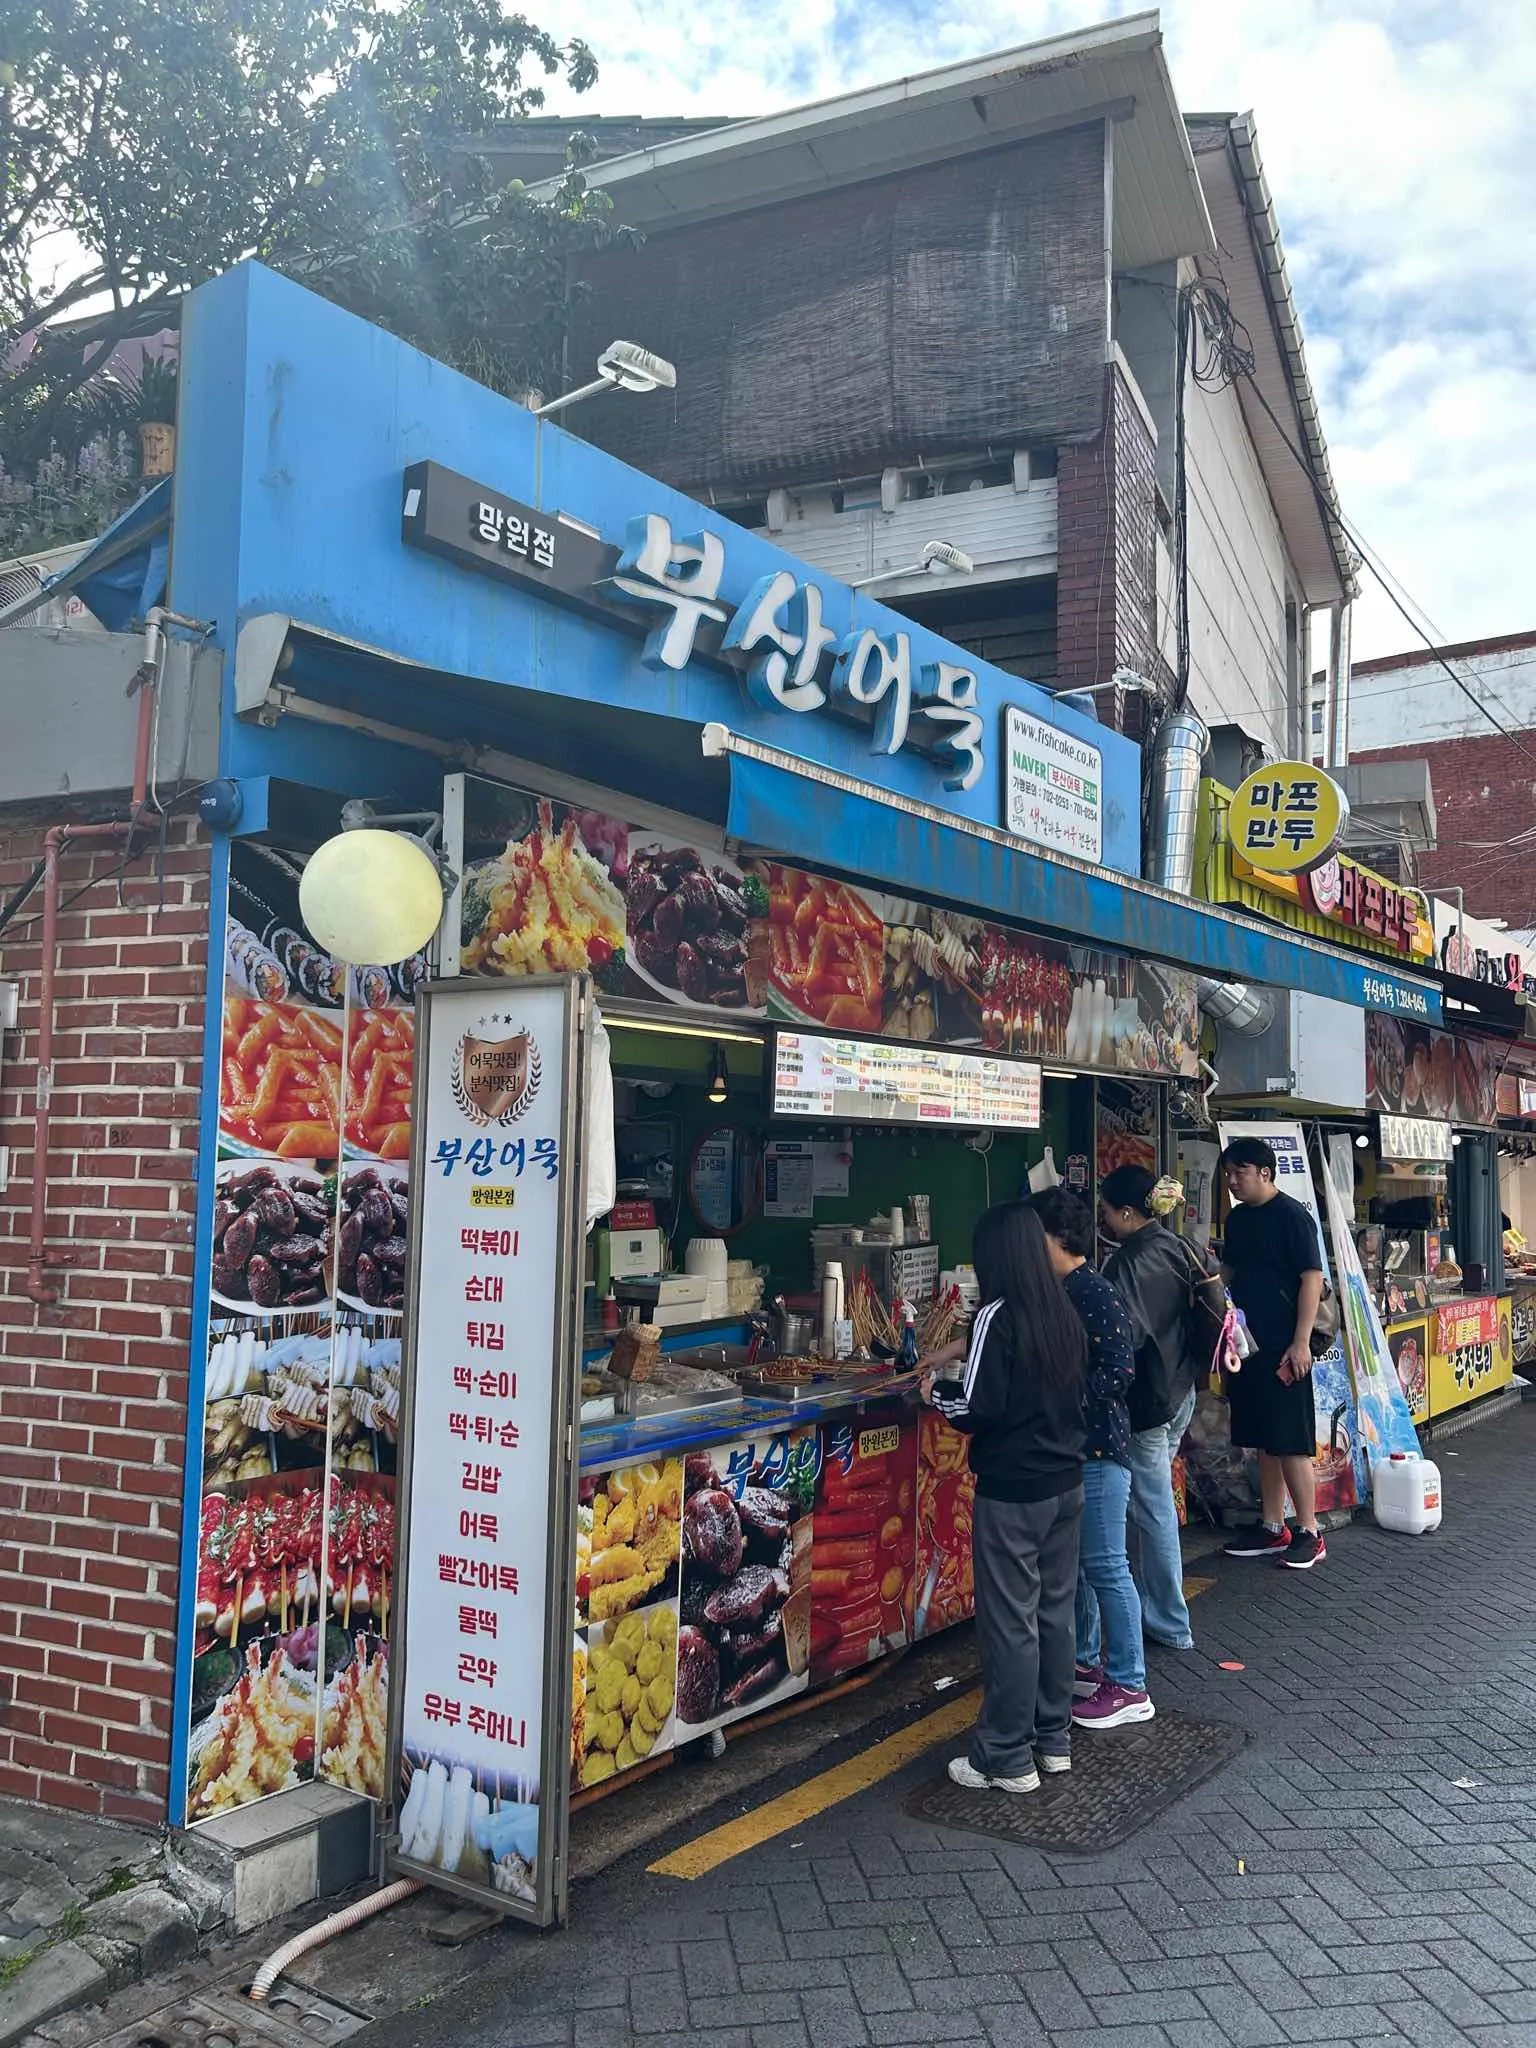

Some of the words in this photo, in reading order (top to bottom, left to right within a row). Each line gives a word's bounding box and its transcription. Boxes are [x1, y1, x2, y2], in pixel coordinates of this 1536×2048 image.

[478, 501, 556, 569] 망원점
[606, 512, 986, 792] 부산어묵
[1013, 750, 1047, 781] NAVER
[1051, 768, 1082, 795] 부산어묵
[1250, 780, 1319, 813] 마포
[1245, 817, 1316, 852] 만두
[1342, 867, 1419, 953] 마포만두
[469, 1051, 522, 1070] 어묵맛집!
[469, 1074, 522, 1094] 분식맛집!
[430, 1137, 561, 1181] 부산어묵
[471, 1188, 515, 1206] 망원본점
[460, 1228, 519, 1257] 떡볶이
[464, 1275, 504, 1304] 순대
[466, 1321, 504, 1351] 튀김
[860, 1430, 899, 1453] 망원본점
[461, 1462, 502, 1495] 김밥
[720, 1422, 856, 1502] 부산어묵
[459, 1510, 499, 1543] 어묵
[438, 1552, 520, 1596] 빨간어묵
[457, 1604, 498, 1640] 물떡
[457, 1652, 498, 1689] 곤약
[423, 1692, 462, 1727] 유부
[467, 1705, 527, 1749] 주머니
